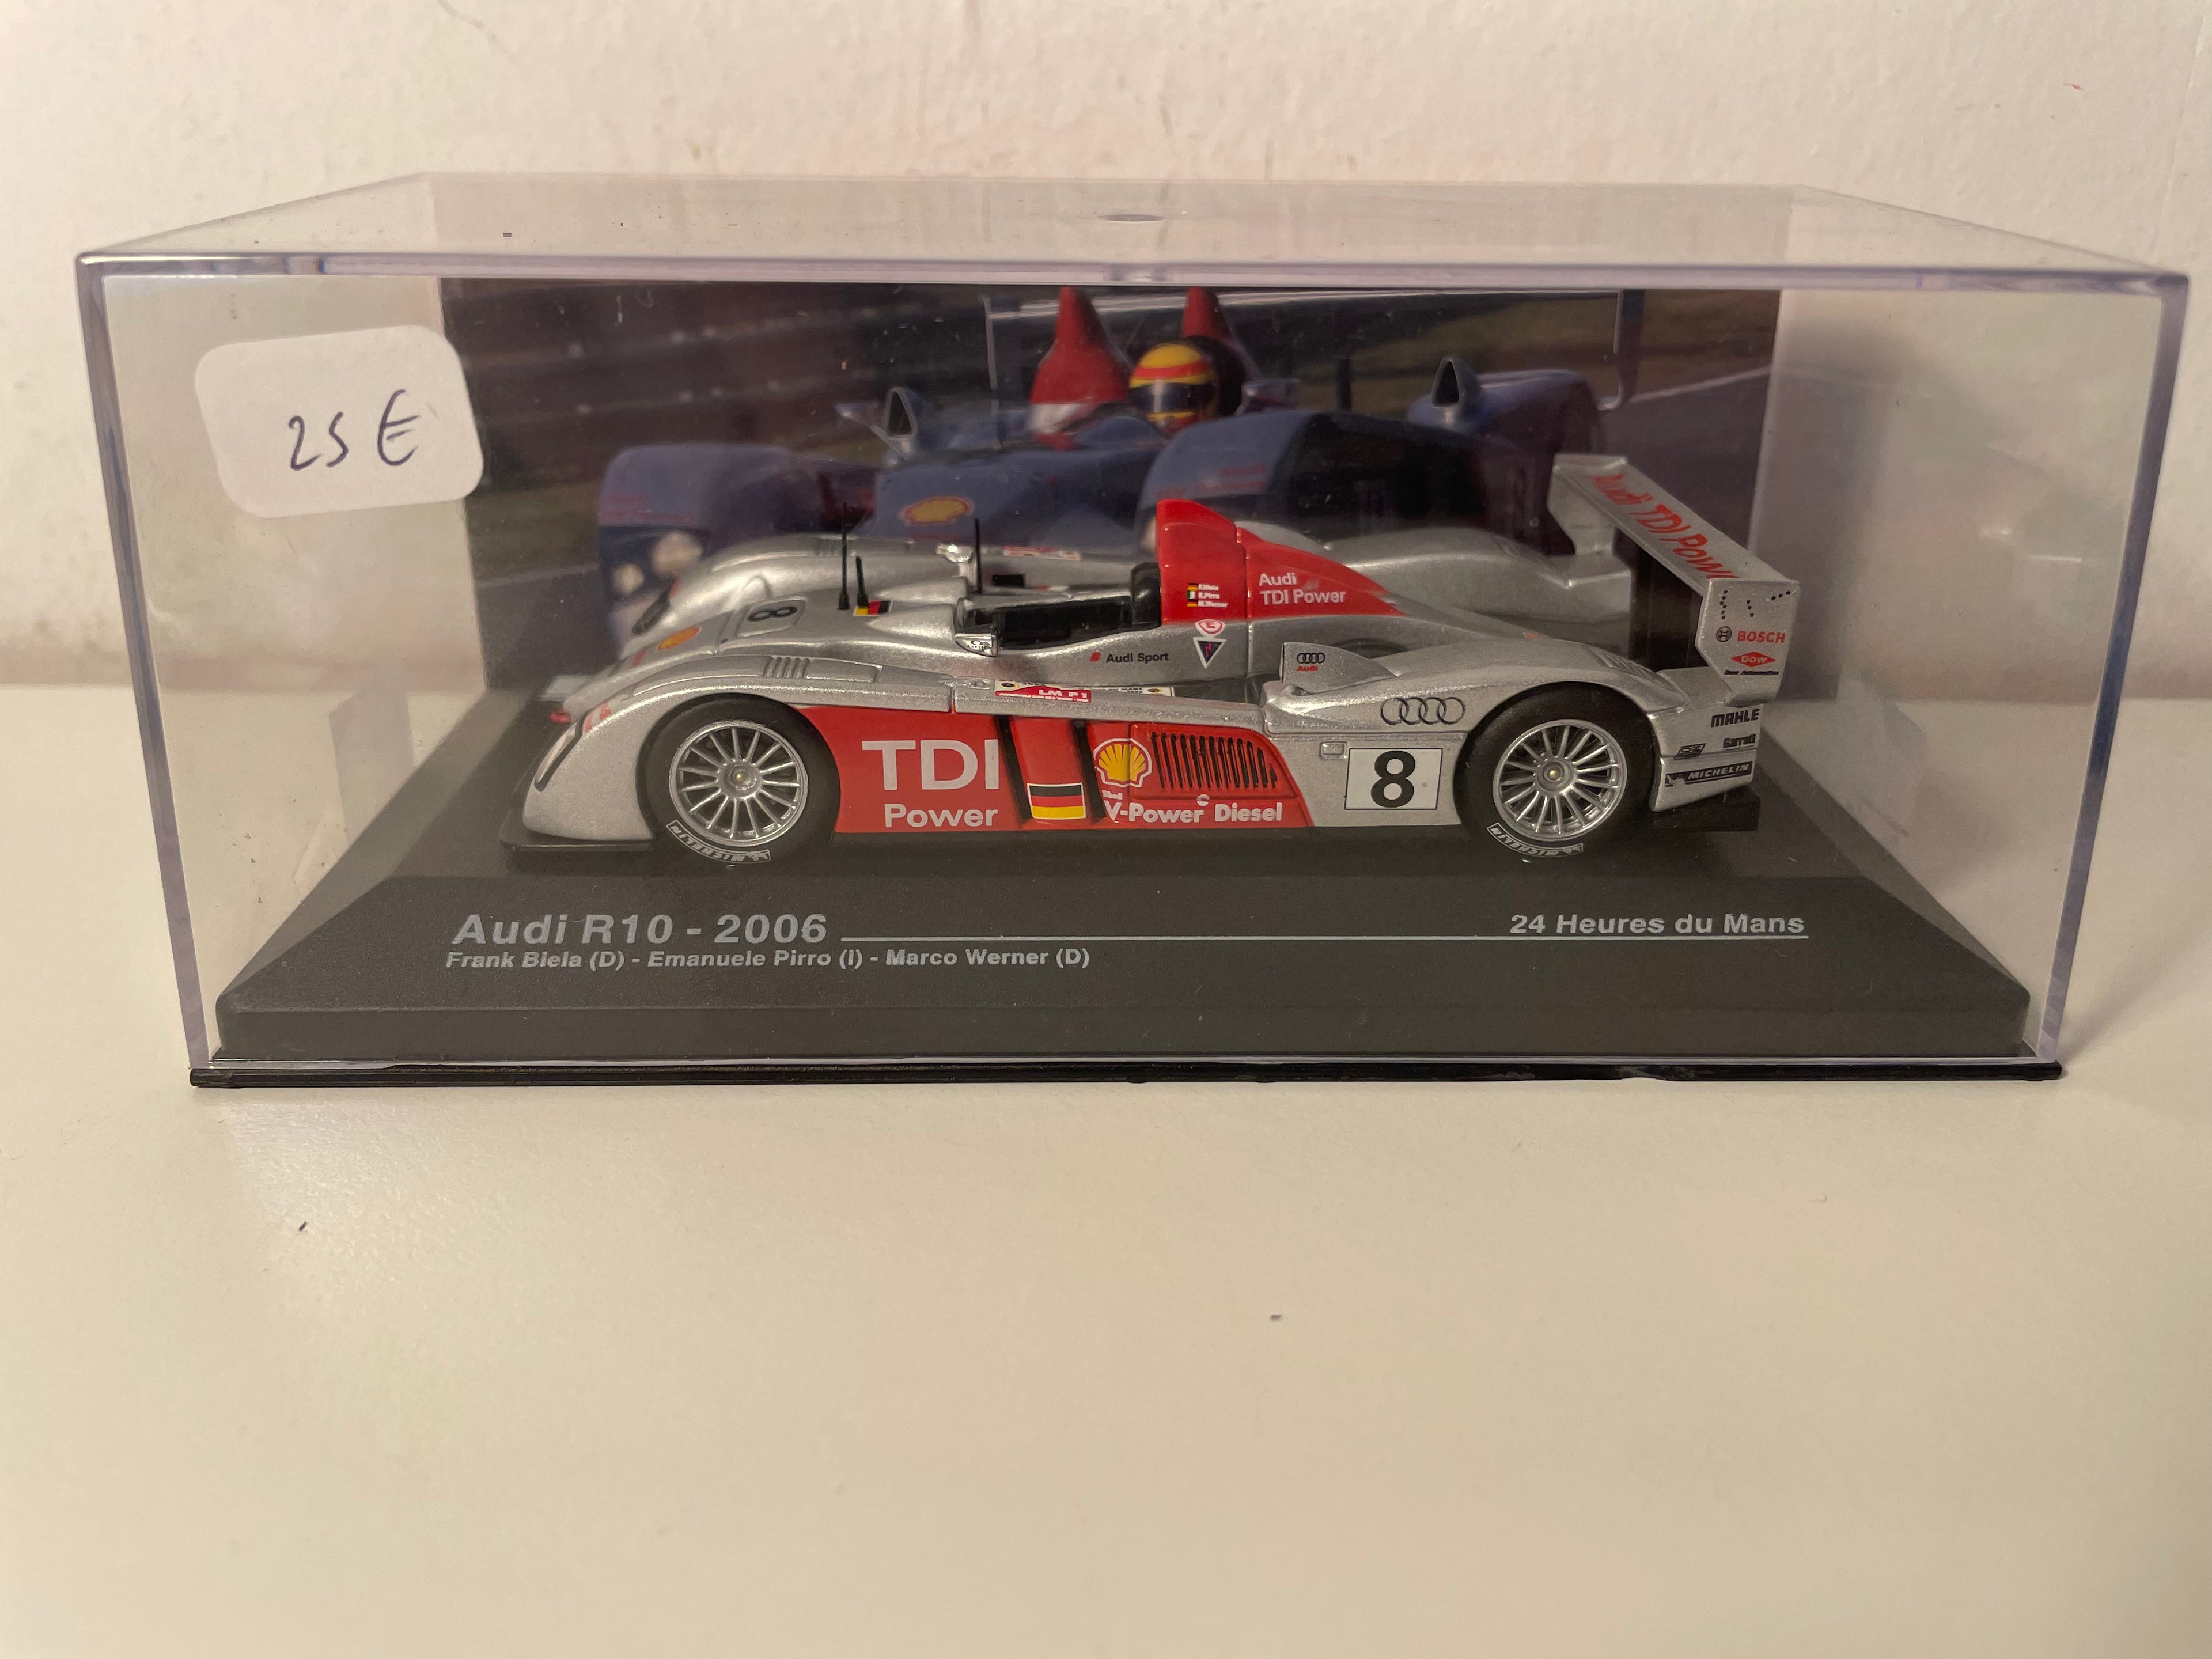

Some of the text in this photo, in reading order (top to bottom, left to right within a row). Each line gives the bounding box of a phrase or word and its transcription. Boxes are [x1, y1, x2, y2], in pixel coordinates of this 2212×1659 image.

[1258, 572, 1298, 586] Audi
[1259, 589, 1347, 605] TDI Power
[1737, 630, 1786, 643] BOSCH
[1105, 653, 1169, 665] Audi Sport
[1710, 708, 1760, 728] MAHLE
[862, 739, 999, 791] TDI
[1687, 763, 1749, 780] MICHELIN
[1370, 750, 1416, 808] 8
[884, 804, 999, 828] Power
[1103, 800, 1283, 823] V-Power Diesel
[452, 914, 569, 944] Audi
[581, 914, 673, 944] R10
[714, 914, 827, 944] 2006
[1509, 914, 1805, 934] 24 Heures du Mans
[445, 951, 516, 968] Frank
[521, 951, 582, 968] Biela
[589, 950, 625, 972] (D)
[647, 950, 766, 967] Emanuele
[774, 949, 832, 967] Pirro
[885, 949, 957, 965] Marco
[965, 948, 1049, 965] Werner
[1055, 948, 1090, 968] (D)
